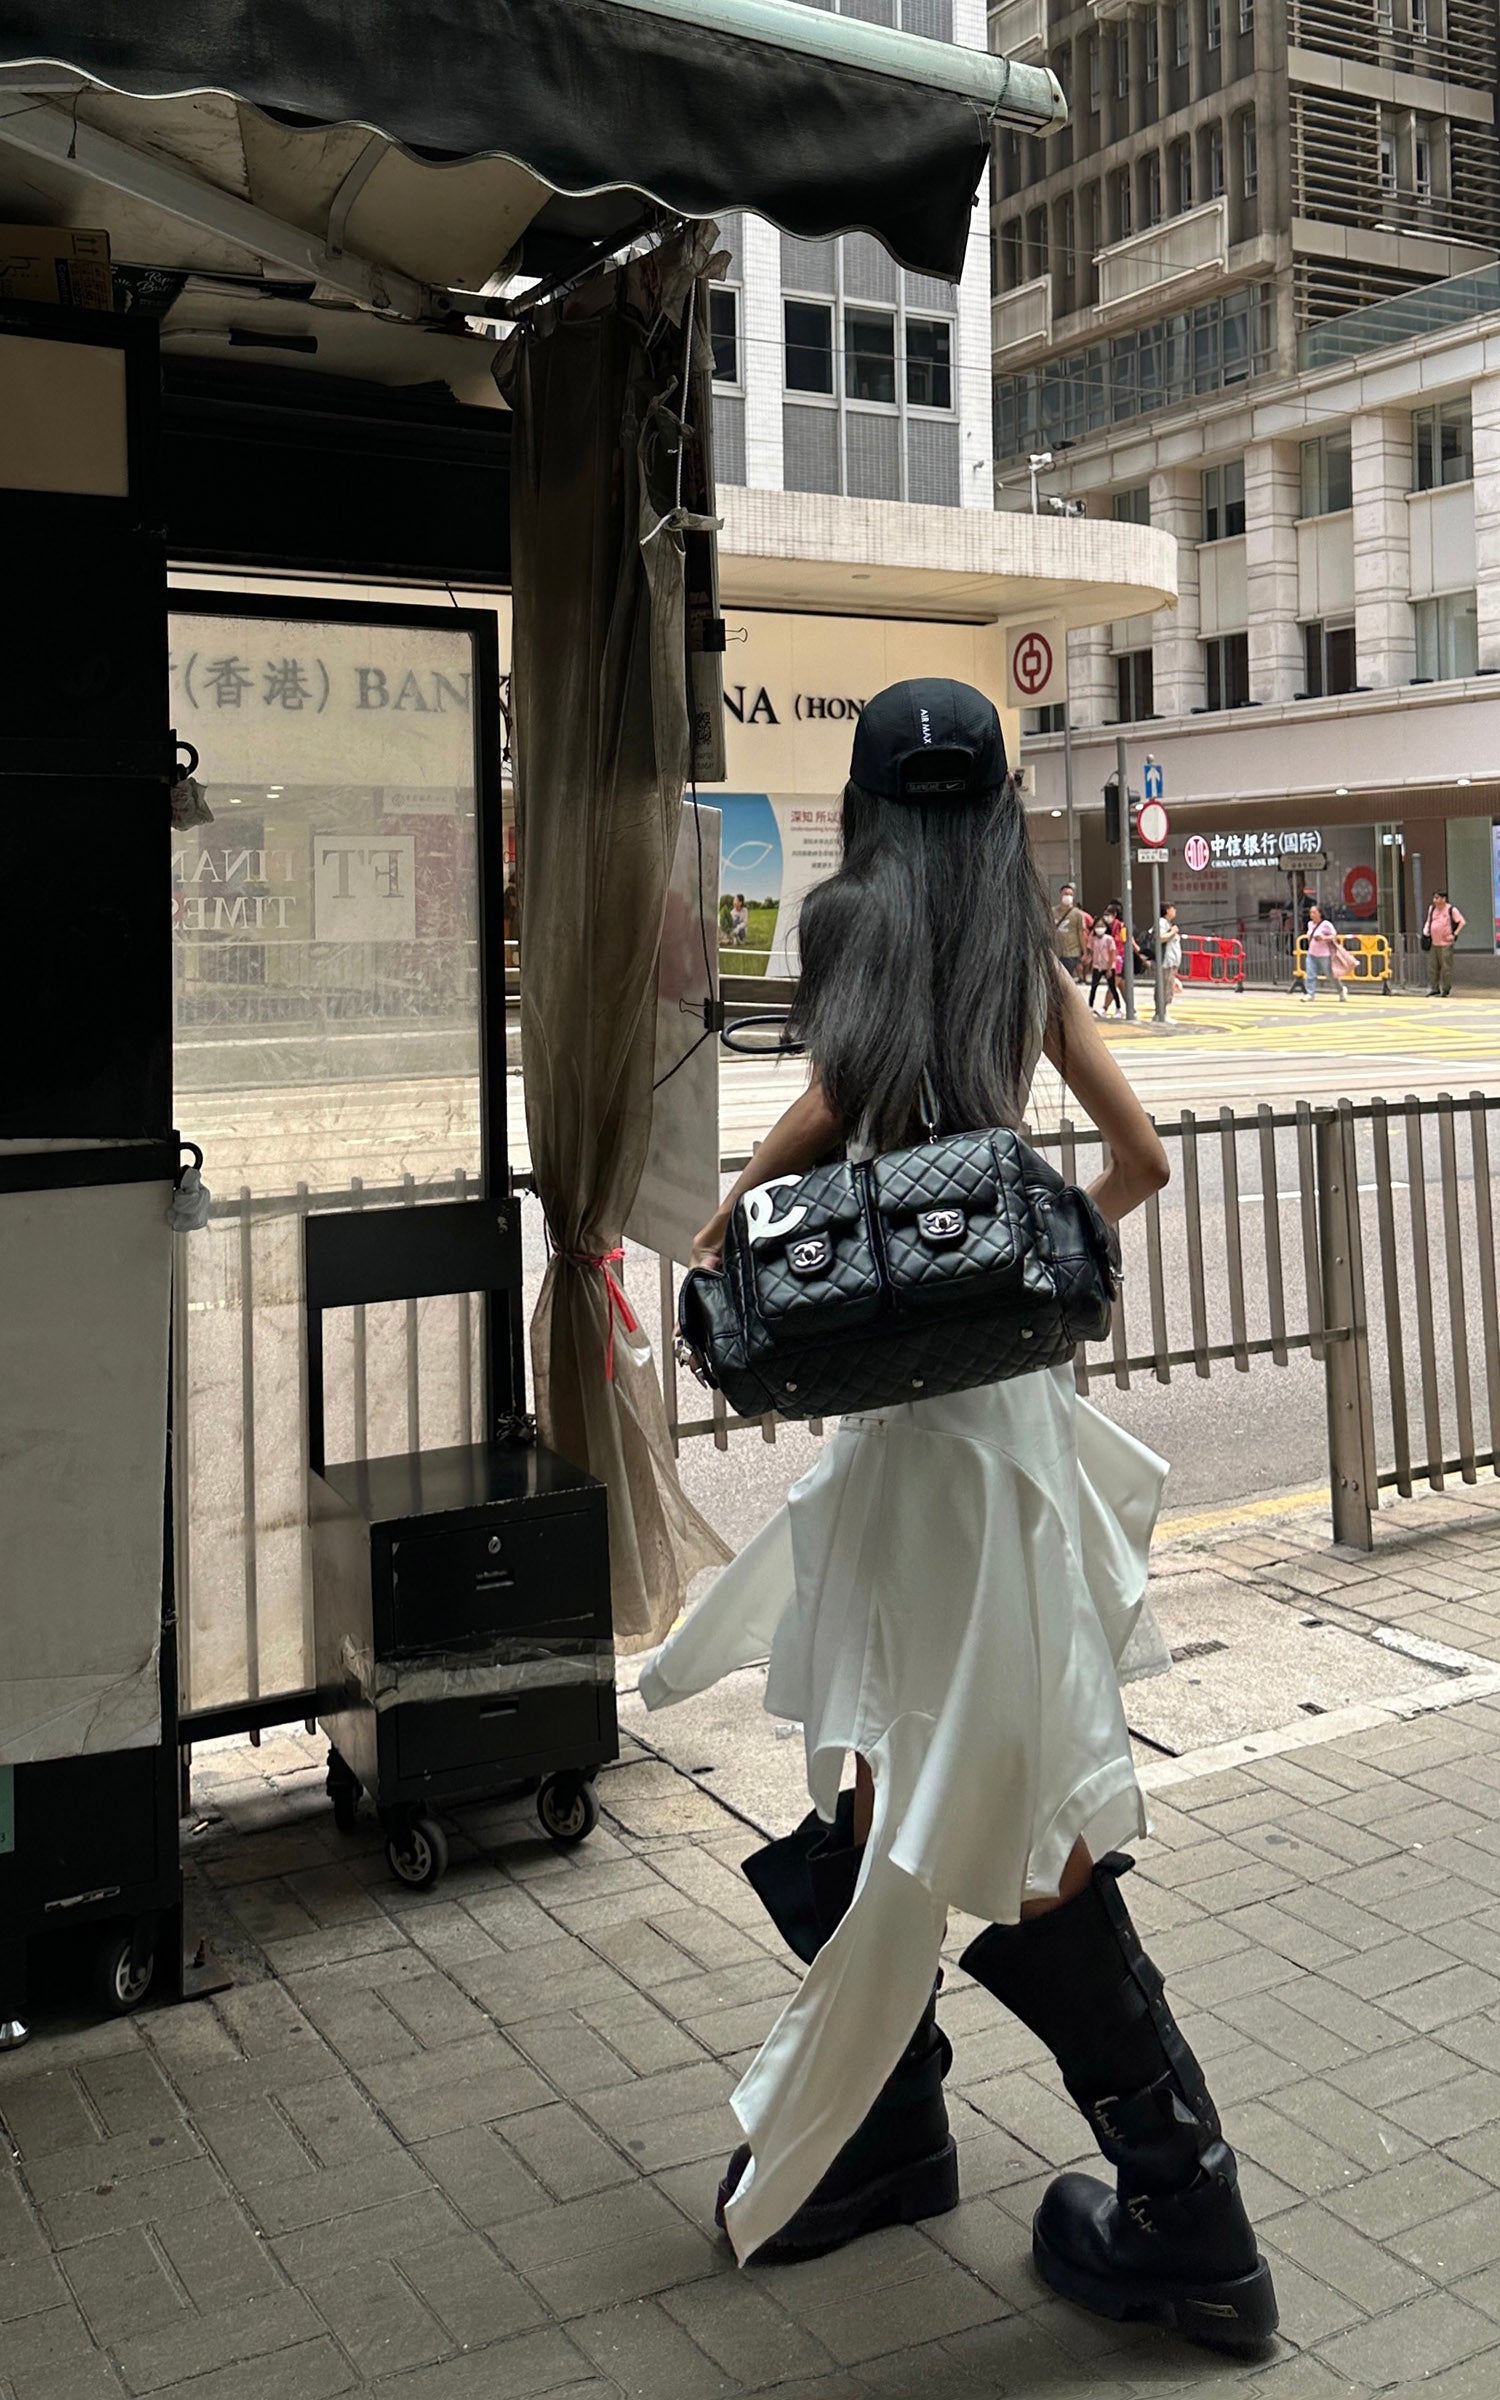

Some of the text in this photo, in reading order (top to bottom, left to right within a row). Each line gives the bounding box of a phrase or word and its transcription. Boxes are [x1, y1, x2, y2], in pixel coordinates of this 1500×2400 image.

[169, 652, 330, 714] (香港)
[354, 667, 470, 713] BAN
[920, 708, 932, 745] AIR MAX
